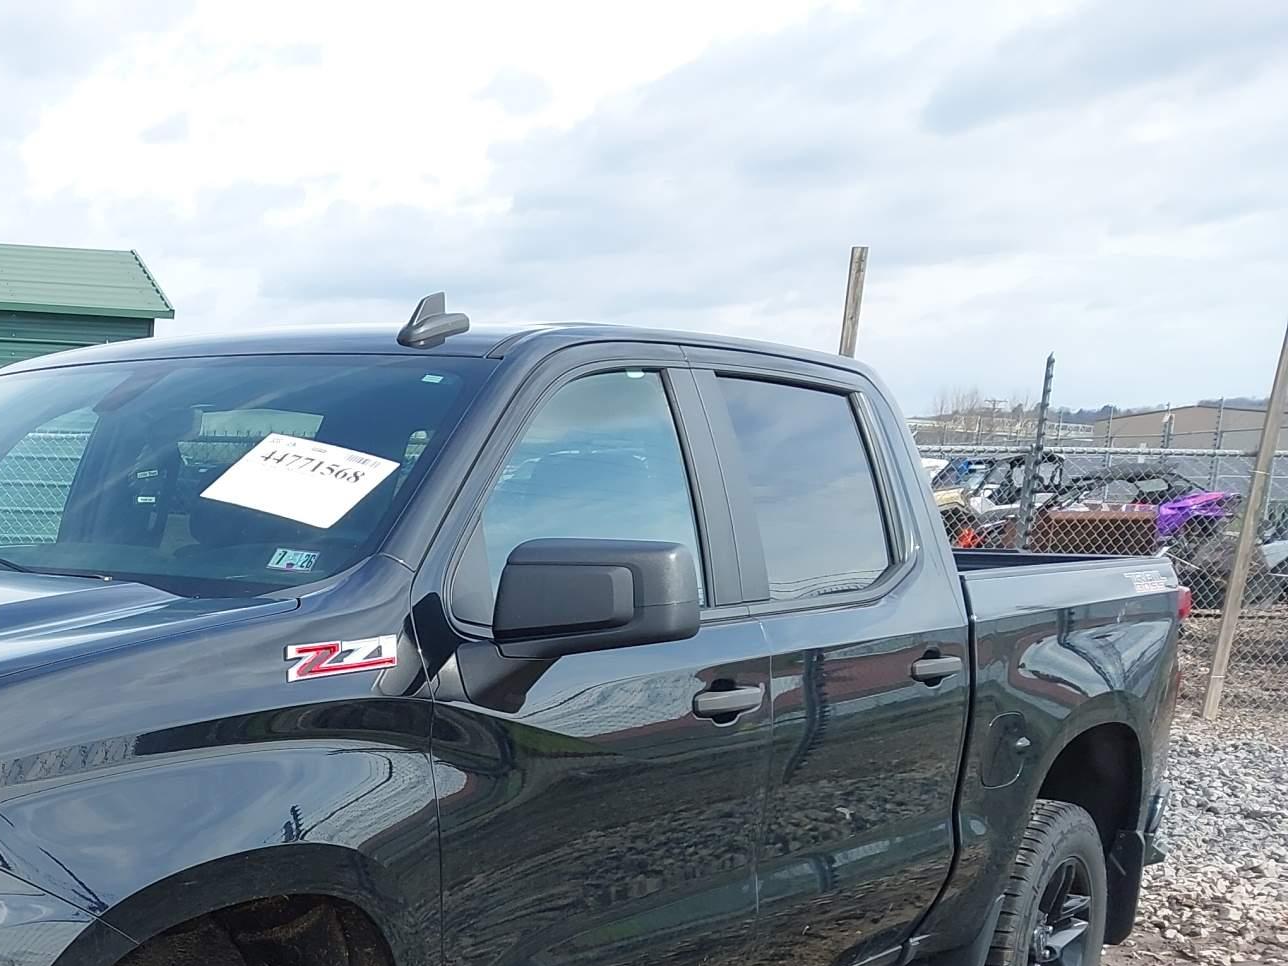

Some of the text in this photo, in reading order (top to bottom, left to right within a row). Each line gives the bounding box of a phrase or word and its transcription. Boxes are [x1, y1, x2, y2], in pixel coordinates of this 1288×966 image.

[259, 449, 366, 485] 44771568
[299, 553, 316, 569] 26
[286, 634, 397, 683] Z71
